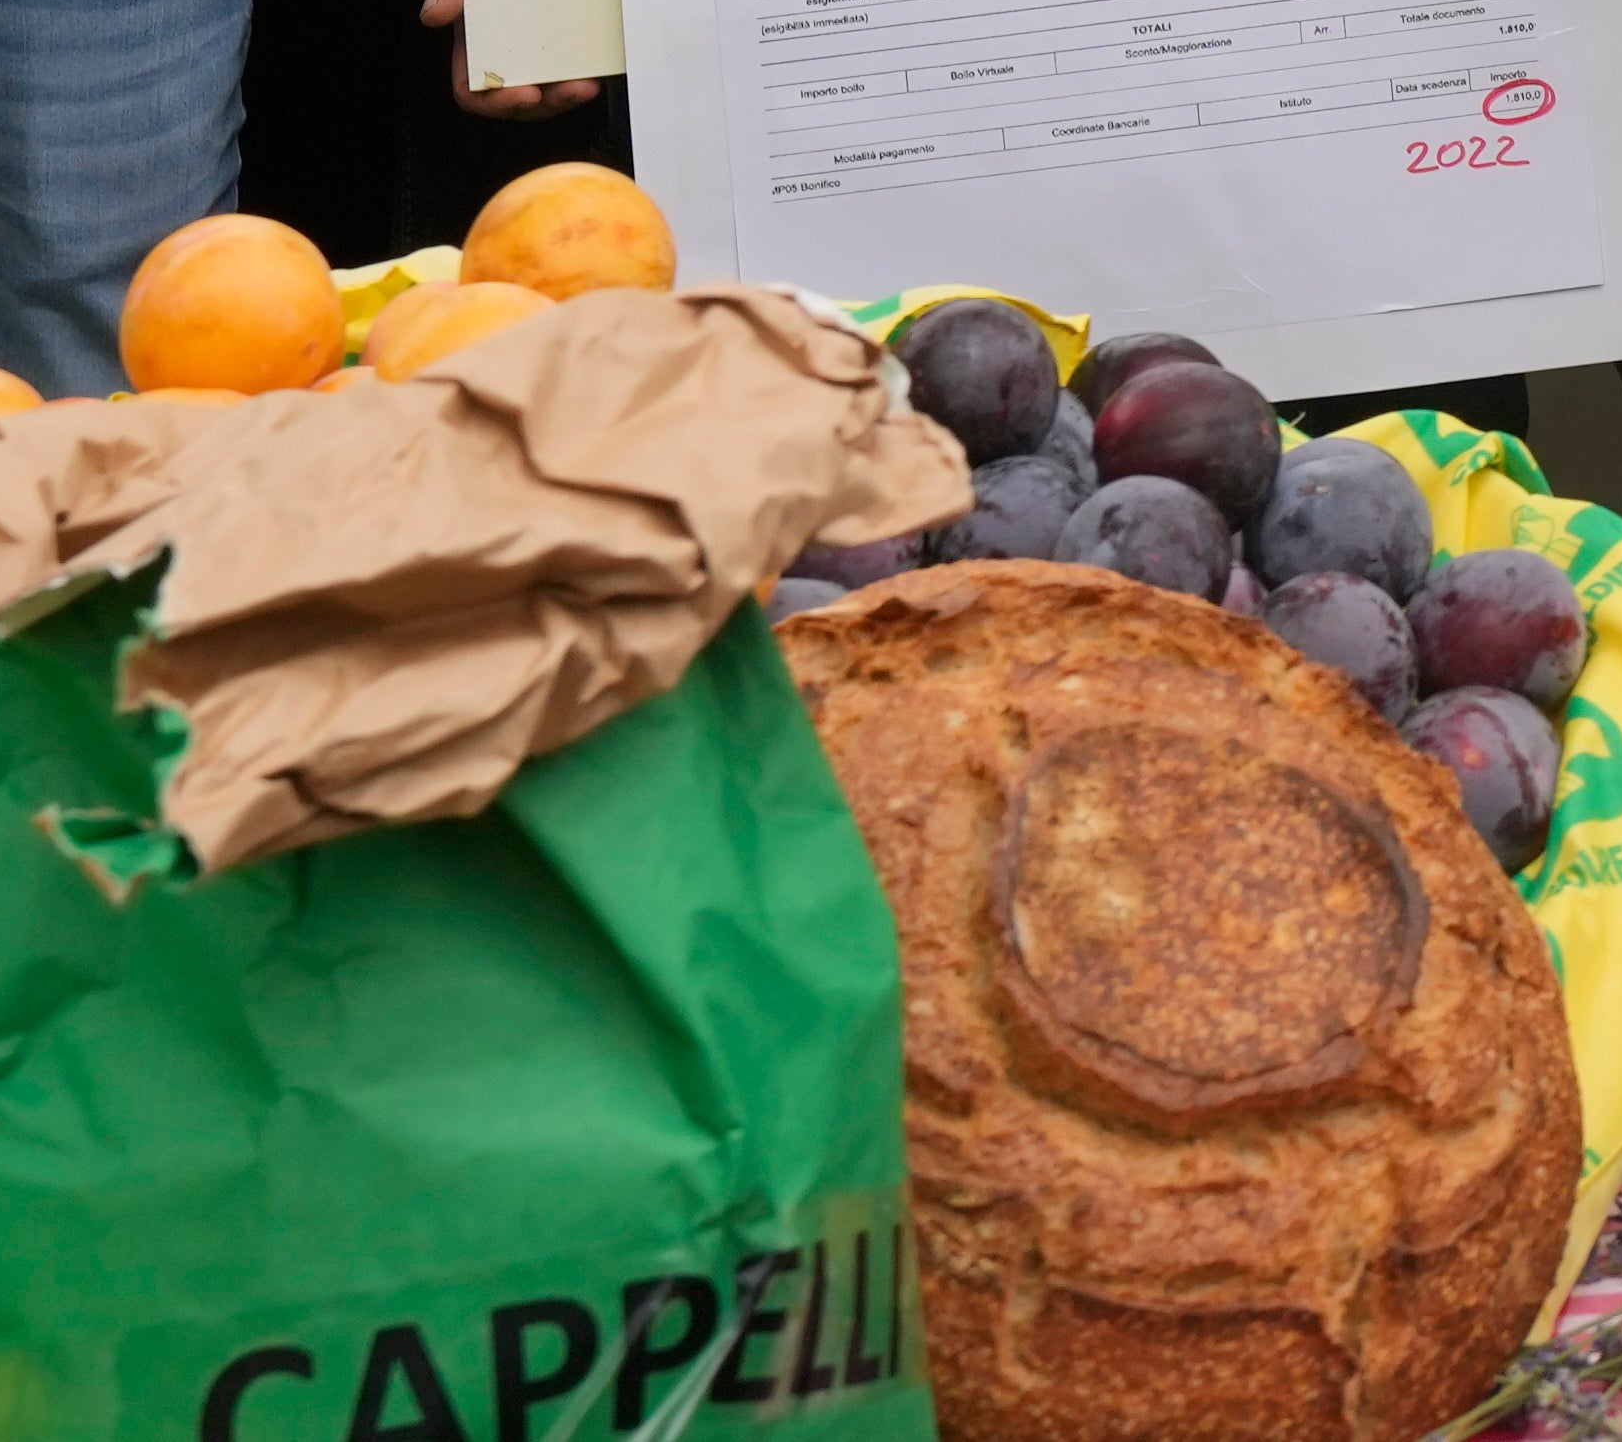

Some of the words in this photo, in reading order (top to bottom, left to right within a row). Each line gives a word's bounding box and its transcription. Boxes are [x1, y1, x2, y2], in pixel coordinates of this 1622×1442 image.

[1432, 5, 1485, 21] documento
[1133, 23, 1172, 36] TOTALI
[977, 64, 1014, 78] Virtuale
[1490, 69, 1527, 83] Importo
[801, 86, 837, 100] Importo
[841, 82, 865, 94] bollo
[1396, 82, 1417, 94] Data
[1419, 77, 1467, 91] scadenza
[1279, 96, 1312, 109] Istituto
[1052, 122, 1104, 138] Coordinate
[1107, 117, 1150, 132] Bancarie
[834, 151, 877, 165] Modalità
[879, 144, 935, 161] pagamento
[1406, 136, 1530, 173] 2022
[801, 178, 840, 192] Bonifico
[200, 1222, 903, 1442] CAPPELLI
